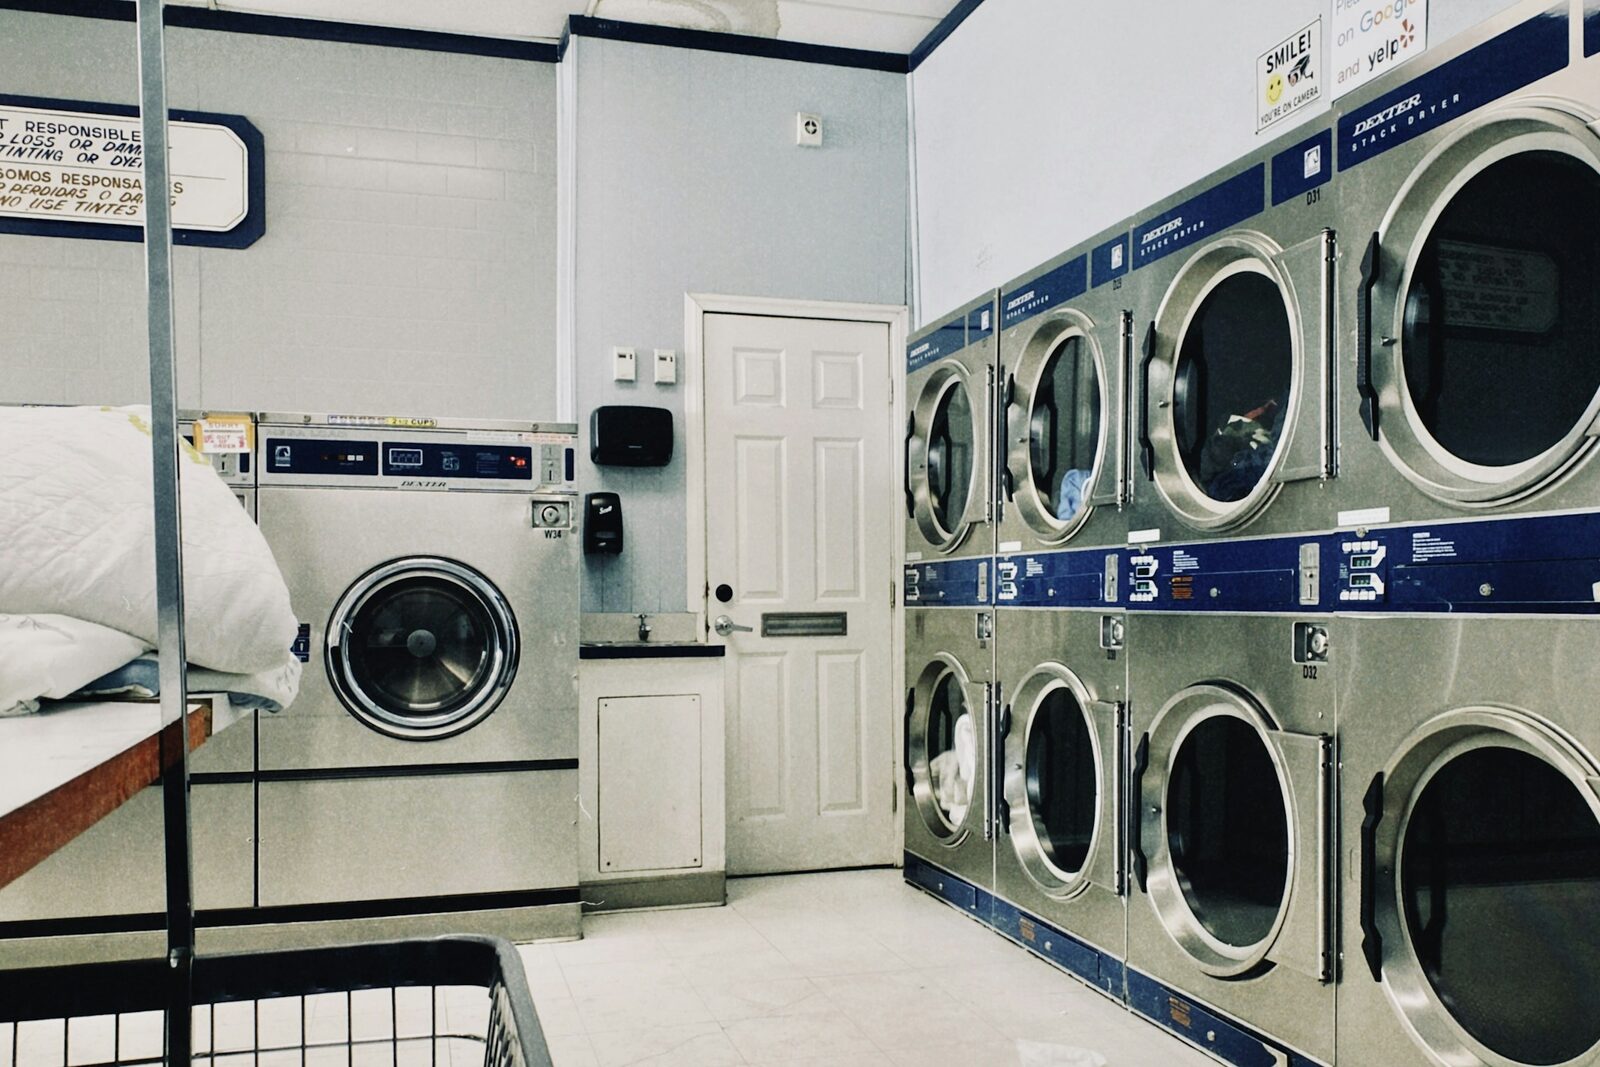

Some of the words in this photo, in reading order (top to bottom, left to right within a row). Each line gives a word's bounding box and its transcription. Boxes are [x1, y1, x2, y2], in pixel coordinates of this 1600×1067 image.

[1337, 27, 1354, 47] on
[1266, 29, 1311, 74] SMILE!
[1337, 58, 1360, 84] and
[1368, 39, 1399, 72] yelp
[1260, 106, 1281, 125] YOU'RE
[1283, 100, 1292, 113] ON
[1293, 86, 1319, 107] CAMERA
[1352, 93, 1422, 137] DEXTER
[26, 120, 142, 142] RESPONSIBLE
[1352, 124, 1397, 152] STACK
[1408, 93, 1460, 125] DRYER
[10, 133, 56, 148] LOSS
[69, 138, 93, 151] OR
[0, 145, 64, 161] TINTING
[77, 152, 99, 164] OR
[111, 155, 143, 168] DYE
[0, 168, 51, 183] SOMOS
[62, 172, 184, 194] RESPONSAS
[9, 183, 88, 199] PERDIDAS
[99, 190, 111, 200] O
[29, 198, 67, 210] USE
[75, 202, 138, 216] TINTES
[1307, 187, 1321, 206] D31
[1141, 216, 1183, 245] DEXTER
[411, 418, 435, 426] CUPS
[545, 530, 561, 539] W34
[1303, 664, 1317, 680] D32
